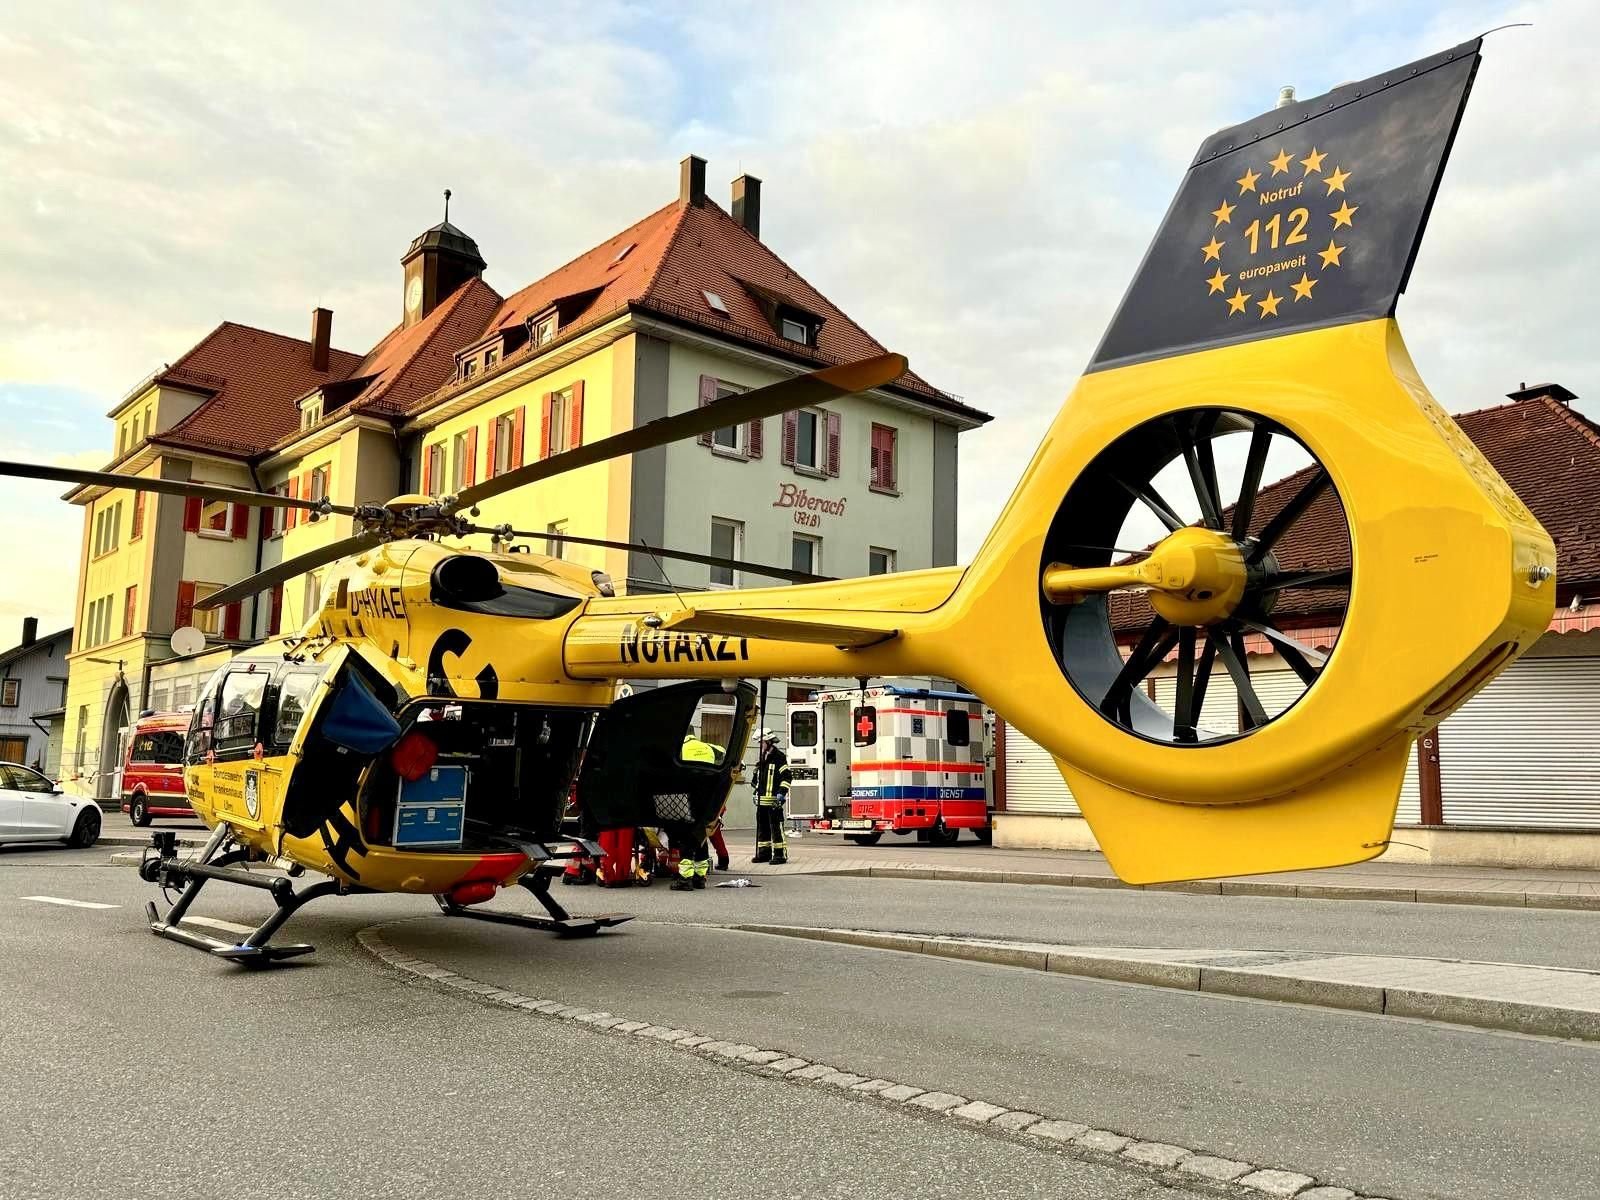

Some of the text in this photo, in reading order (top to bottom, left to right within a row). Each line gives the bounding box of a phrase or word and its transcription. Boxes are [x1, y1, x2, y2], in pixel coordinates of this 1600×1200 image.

[1260, 181, 1304, 206] Notruf
[1244, 207, 1309, 254] 112
[1239, 254, 1306, 280] europaweit
[772, 483, 847, 516] Biberach
[350, 587, 405, 619] D-HYAE
